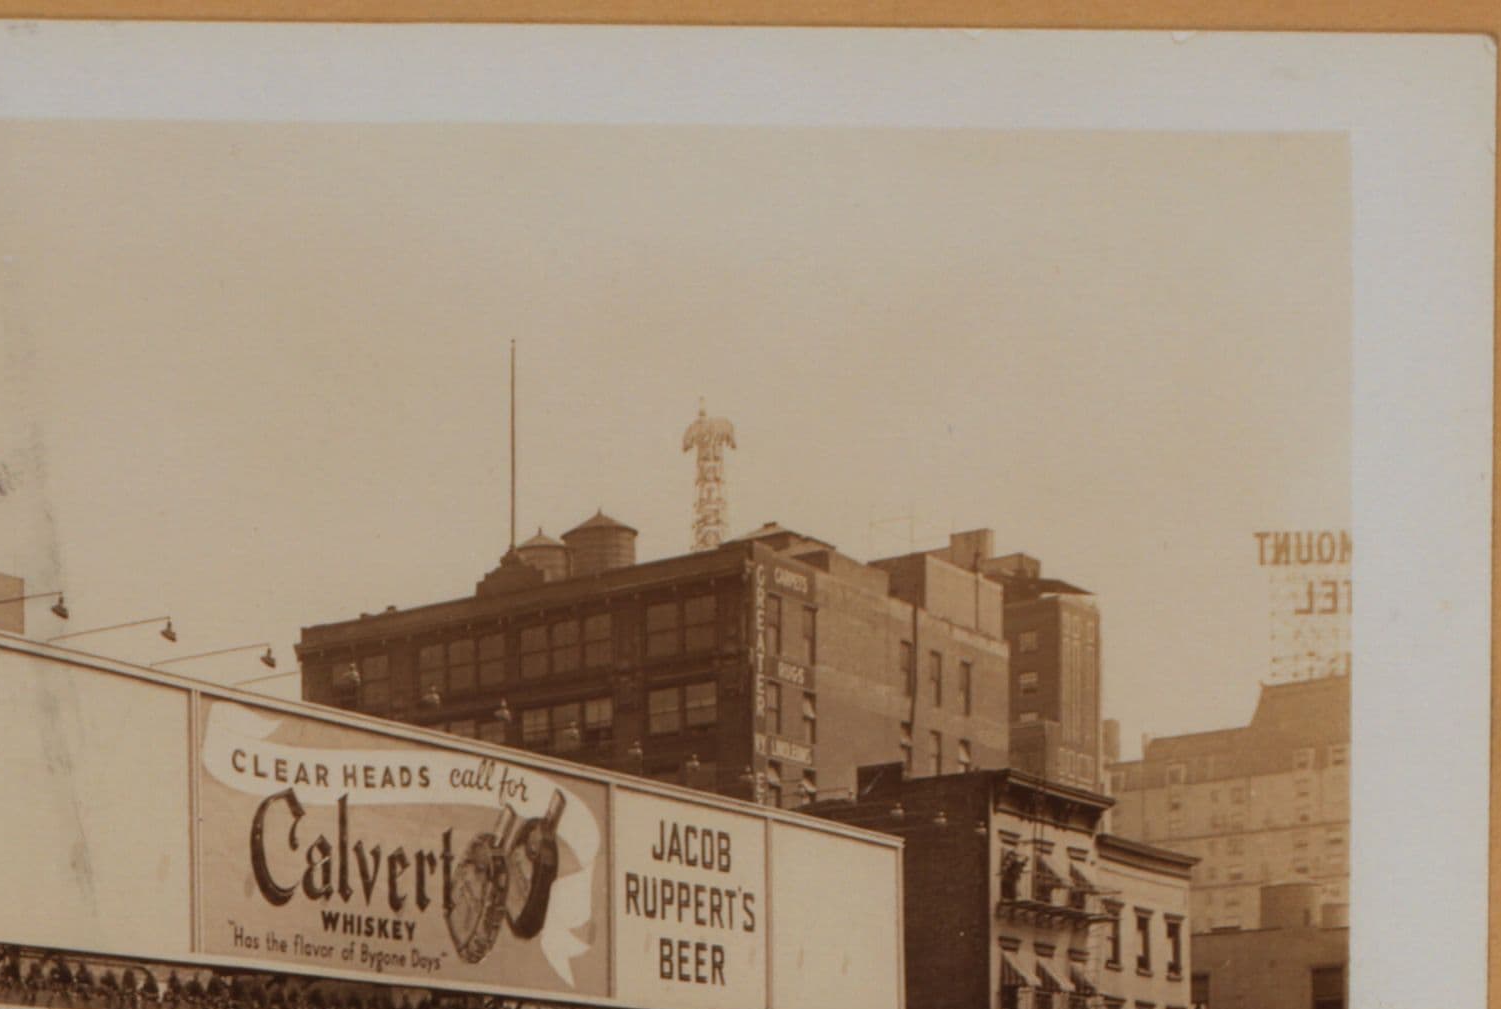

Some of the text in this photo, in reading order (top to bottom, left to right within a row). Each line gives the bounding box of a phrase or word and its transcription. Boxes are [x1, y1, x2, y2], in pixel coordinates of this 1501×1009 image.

[231, 748, 529, 802] CLEAR HEADS call for
[251, 786, 456, 912] Calvert
[652, 819, 732, 873] JACOB
[320, 910, 416, 942] WHISKEY
[625, 872, 757, 933] RUPPERT'S
[266, 931, 288, 953] the
[294, 933, 334, 958] flavor
[341, 941, 356, 961] of
[360, 943, 407, 973] Bygone
[659, 937, 727, 987] BEER
